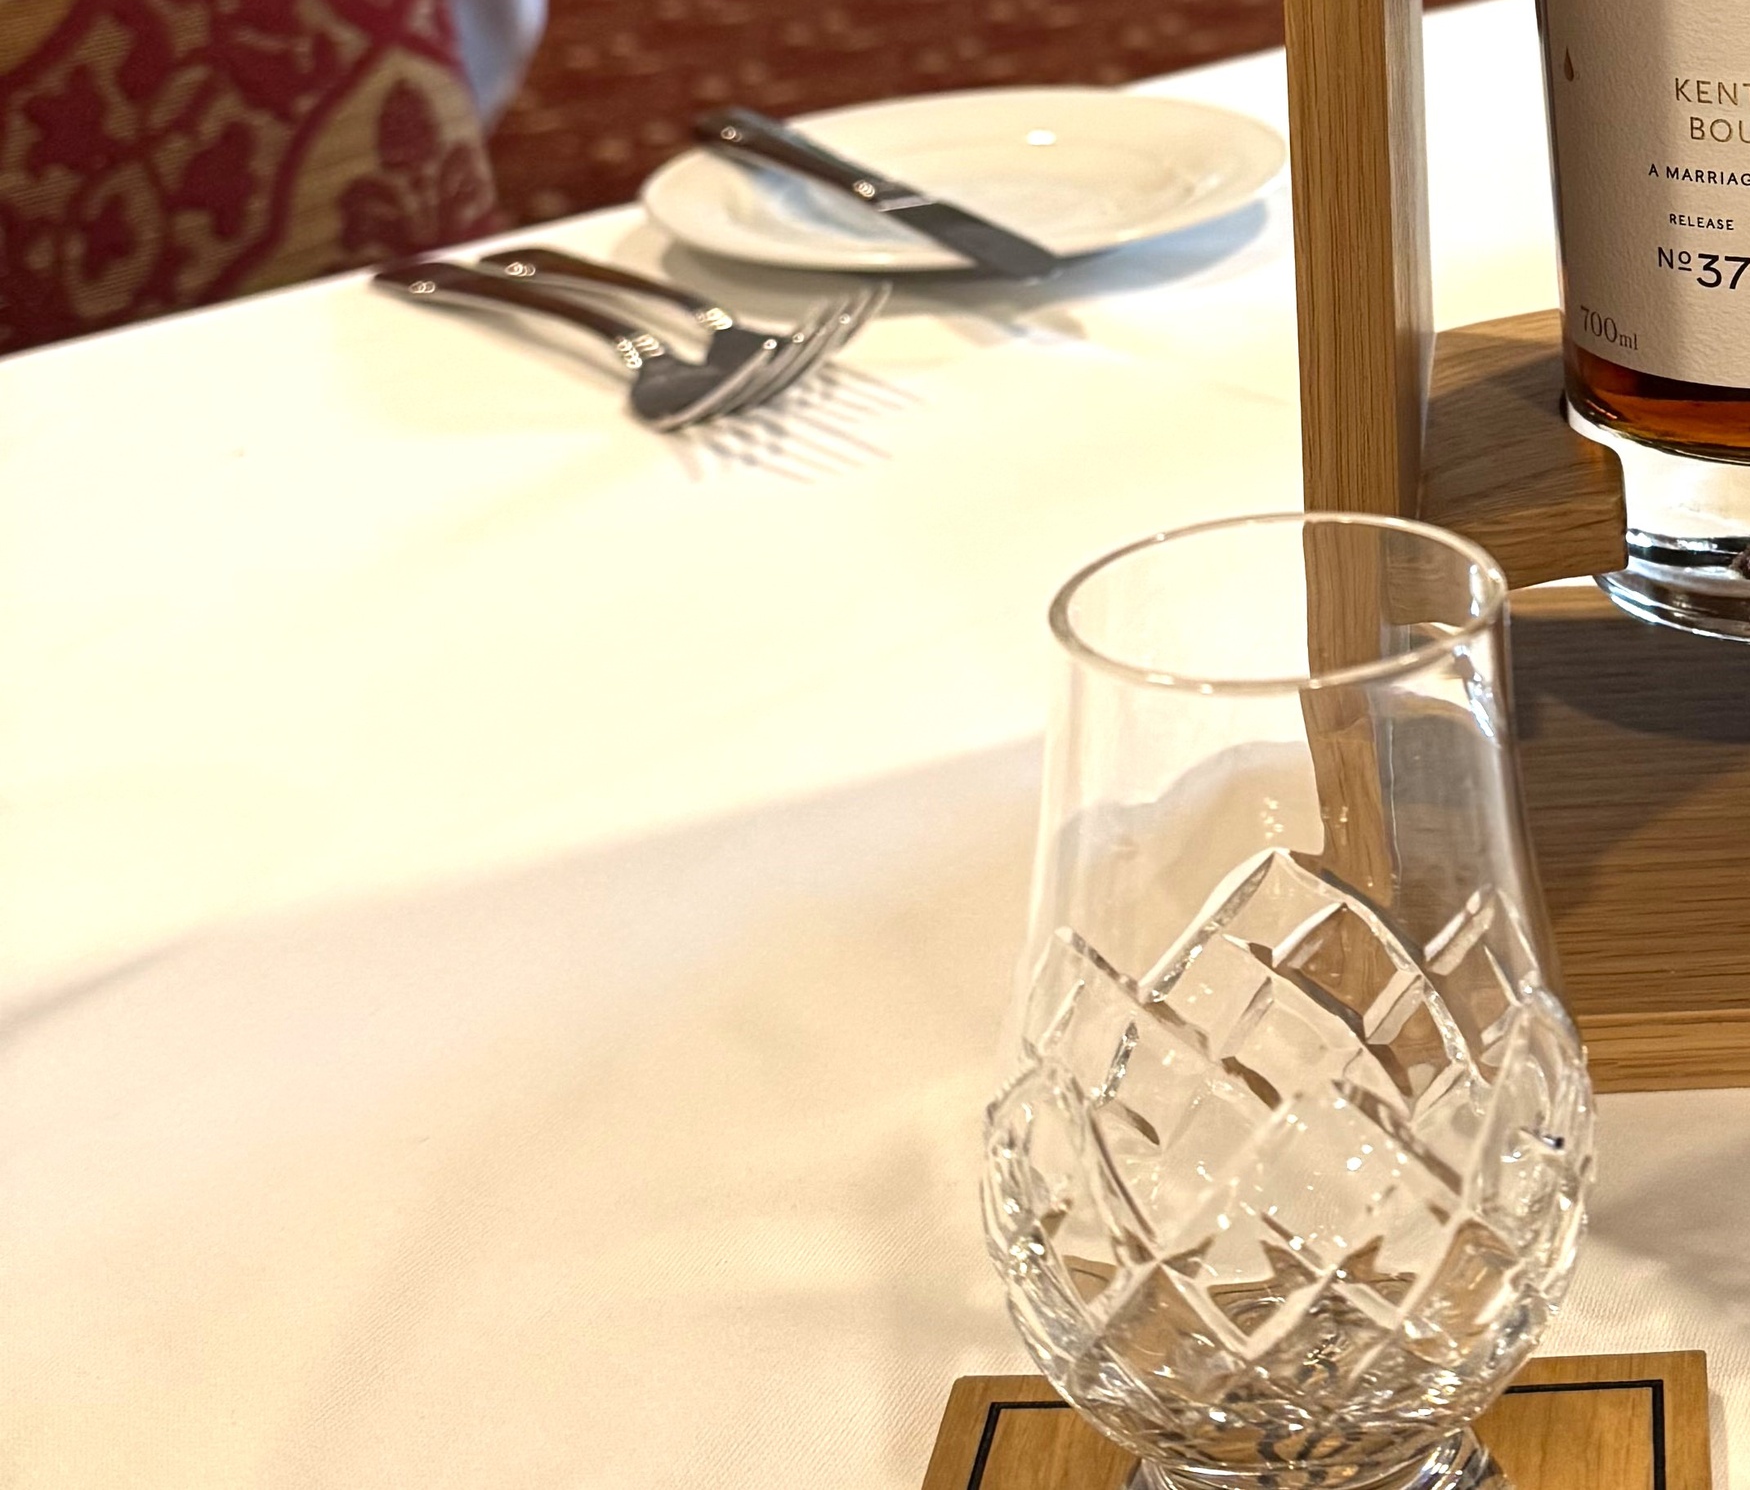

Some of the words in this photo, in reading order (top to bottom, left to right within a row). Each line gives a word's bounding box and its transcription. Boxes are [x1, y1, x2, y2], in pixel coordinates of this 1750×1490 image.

[1648, 163, 1659, 177] A
[1670, 214, 1734, 230] RELEASE
[1580, 305, 1639, 351] 700ml
